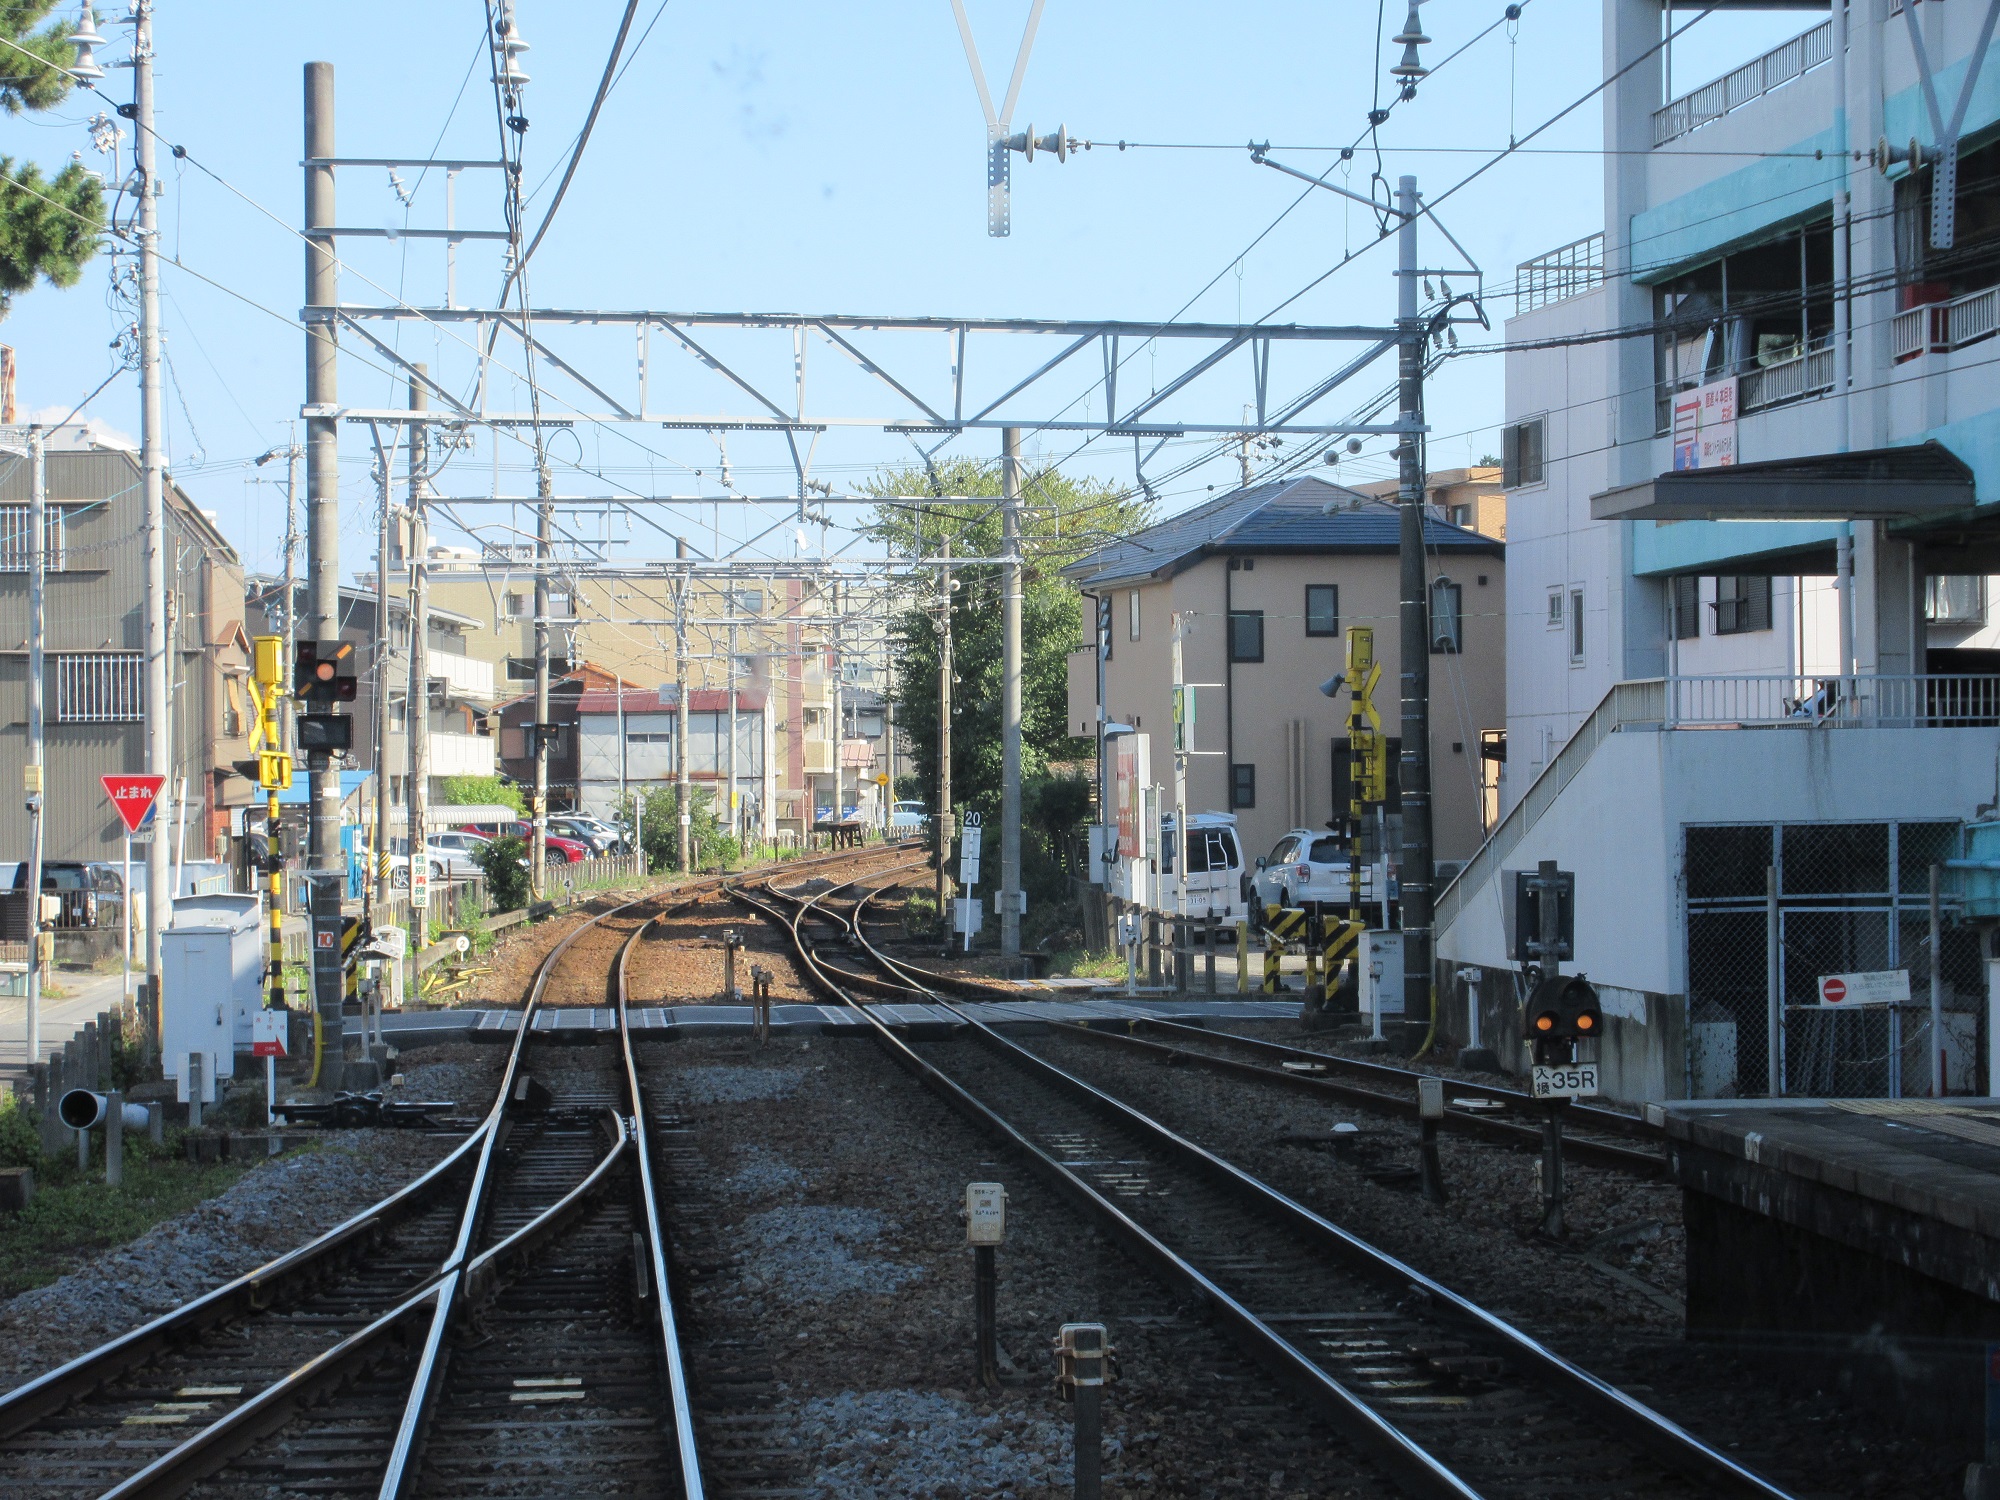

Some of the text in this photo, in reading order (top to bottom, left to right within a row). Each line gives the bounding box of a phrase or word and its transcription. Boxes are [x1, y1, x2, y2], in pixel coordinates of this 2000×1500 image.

[114, 785, 153, 799] 止まれ
[964, 810, 981, 826] 20
[414, 855, 427, 906] 種別再確認
[318, 932, 334, 947] 10
[1551, 1070, 1595, 1090] 35R
